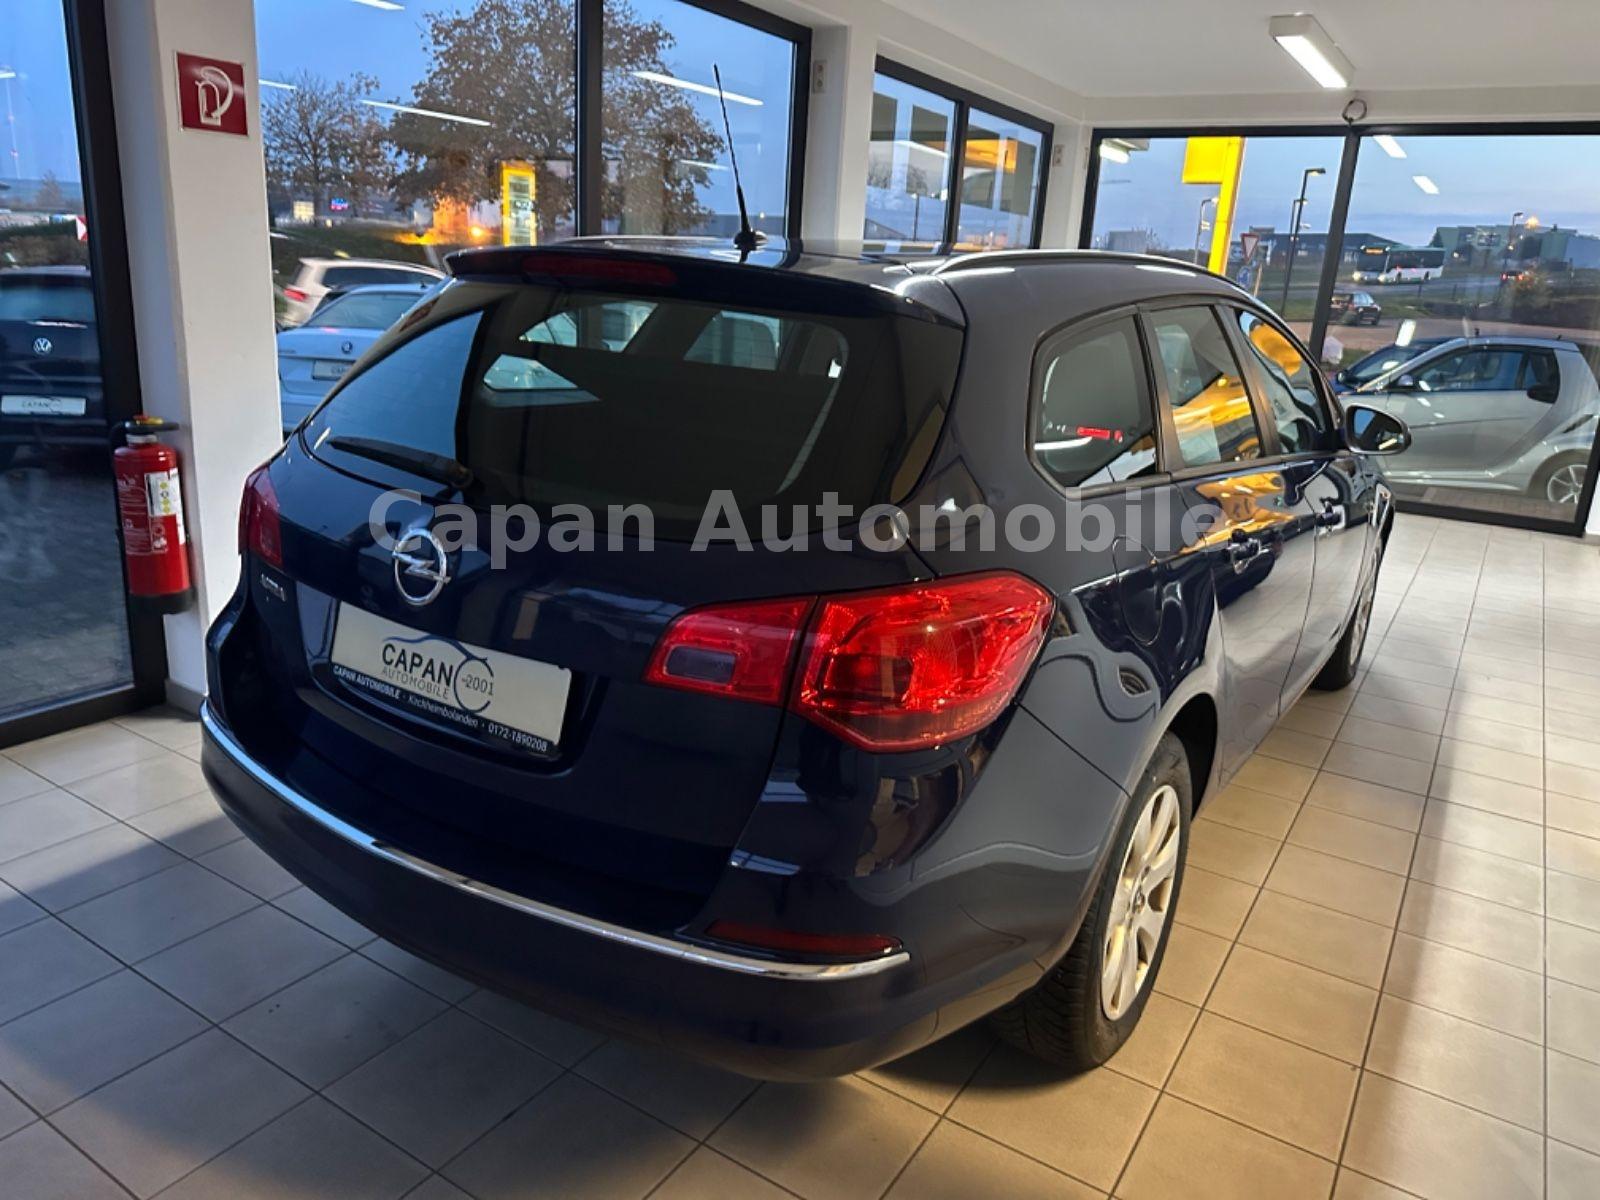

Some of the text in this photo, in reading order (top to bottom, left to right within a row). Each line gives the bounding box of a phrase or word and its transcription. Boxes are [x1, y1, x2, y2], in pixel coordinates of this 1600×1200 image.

[332, 665, 356, 682] CAPAN
[356, 675, 401, 700] AUTOMOBILE
[381, 666, 450, 699] AUTOMOBILE
[382, 643, 453, 687] CAPAN
